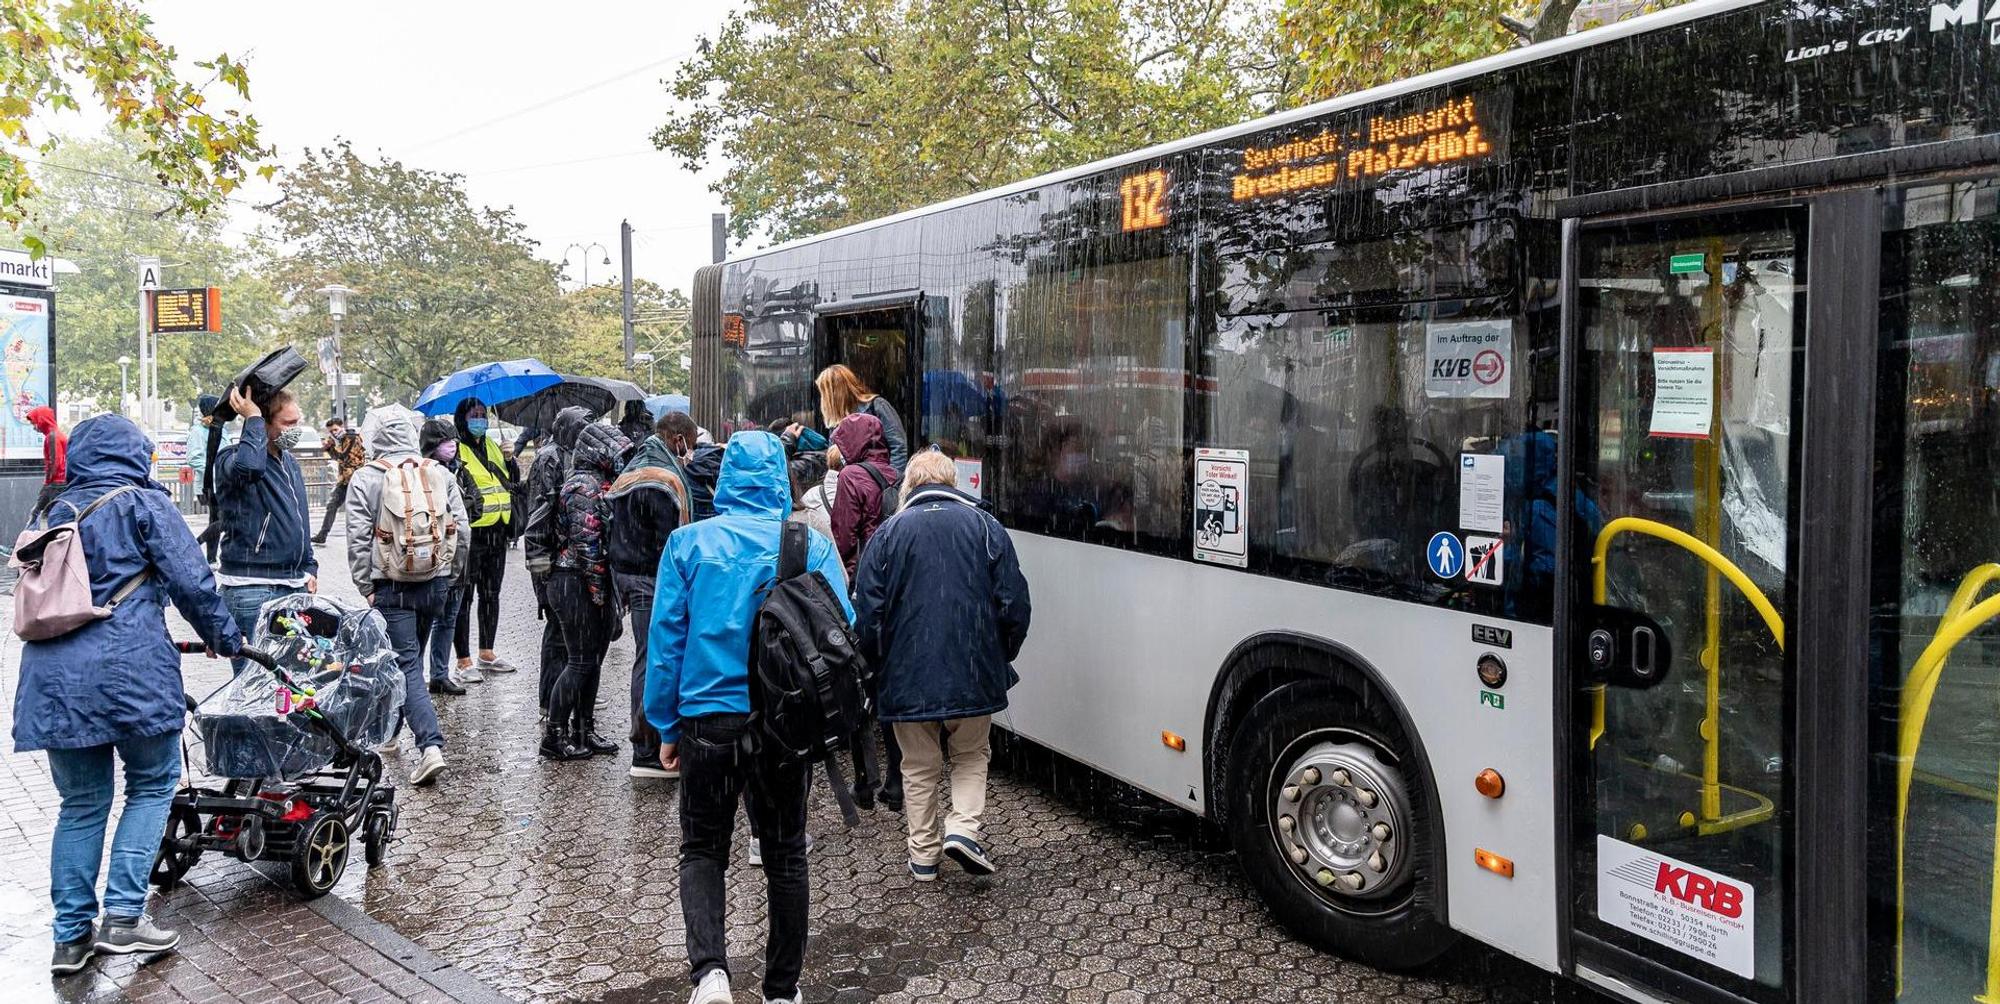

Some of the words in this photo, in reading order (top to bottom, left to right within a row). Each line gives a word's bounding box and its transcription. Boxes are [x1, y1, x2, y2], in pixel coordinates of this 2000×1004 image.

[1784, 39, 1849, 63] Lion's
[1858, 26, 1912, 46] City
[1369, 95, 1475, 143] Heumarkt
[1232, 162, 1338, 202] Breslauer
[1347, 125, 1490, 178] Platz/Hbf.
[1119, 171, 1165, 231] 132
[143, 268, 157, 286] A
[1437, 334, 1448, 344] Im
[1449, 334, 1483, 345] Auftrag
[1485, 333, 1500, 342] der
[1432, 358, 1472, 378] KVB
[1473, 624, 1509, 644] EEV
[1655, 861, 1744, 919] KRB
[1619, 891, 1659, 910] Bonnstraße
[1660, 906, 1674, 916] 260
[1680, 913, 1704, 926] 50354
[1706, 922, 1729, 937] Hürth
[1629, 903, 1658, 919] Telefon:
[1657, 914, 1681, 928] 02233
[1629, 911, 1658, 927] Telefax:
[1657, 922, 1681, 936] 02233
[1719, 915, 1745, 931] GmbH
